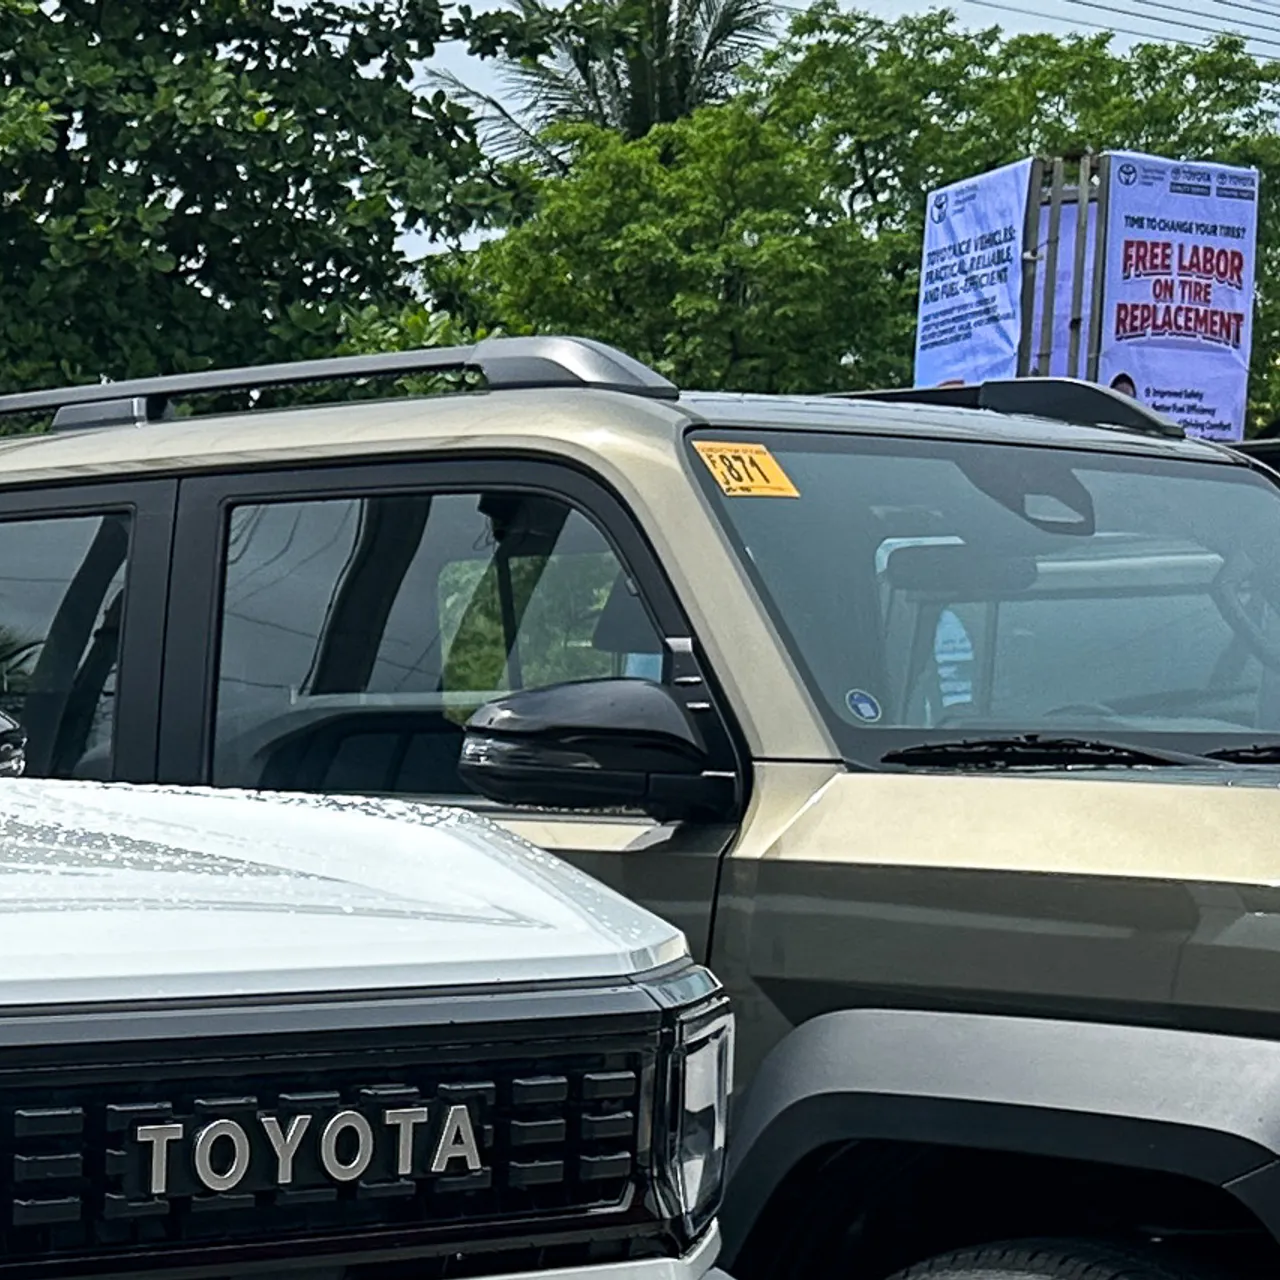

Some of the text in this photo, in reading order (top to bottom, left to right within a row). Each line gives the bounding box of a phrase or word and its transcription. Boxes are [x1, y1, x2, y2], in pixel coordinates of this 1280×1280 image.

[1124, 215, 1145, 229] TIME
[1195, 222, 1218, 237] YOUR
[1122, 240, 1244, 290] FREE LABOR
[1152, 278, 1212, 304] ON TIRE
[1115, 303, 1244, 349] REPLACEMENT
[719, 454, 770, 484] 871
[137, 1104, 482, 1194] TOYOTA
